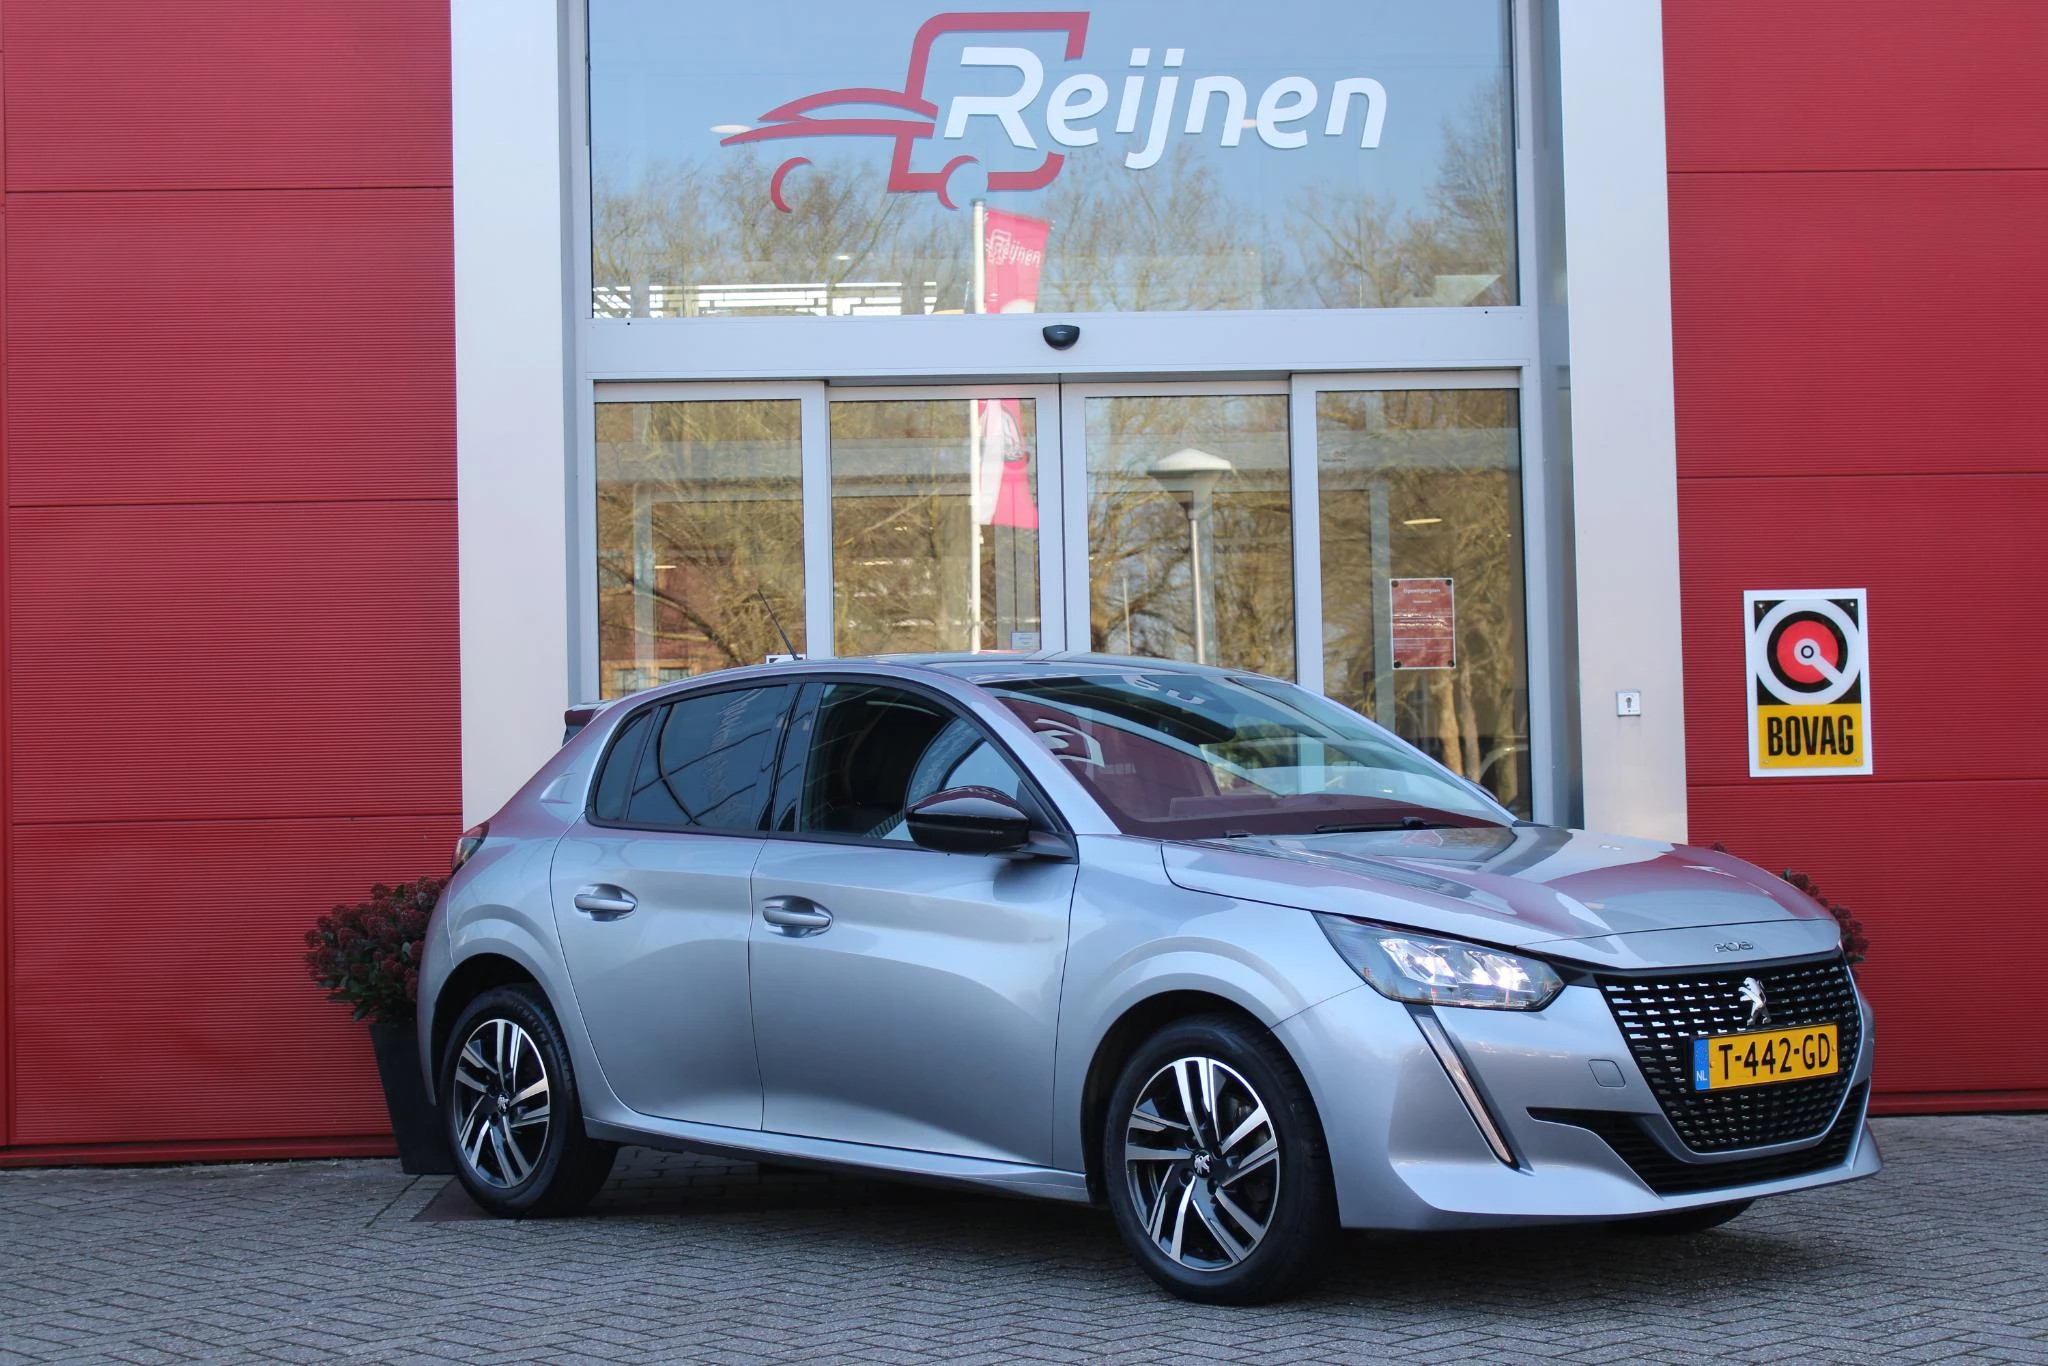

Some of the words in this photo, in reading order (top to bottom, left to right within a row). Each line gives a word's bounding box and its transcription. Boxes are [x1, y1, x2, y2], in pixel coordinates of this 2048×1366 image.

[944, 47, 1387, 170] Reijnen
[993, 234, 1041, 267] Reijnen
[1767, 714, 1854, 756] BOVAG
[1713, 940, 1754, 953] 208
[1696, 1070, 1708, 1081] NL
[1718, 1033, 1831, 1080] T-442-GD
